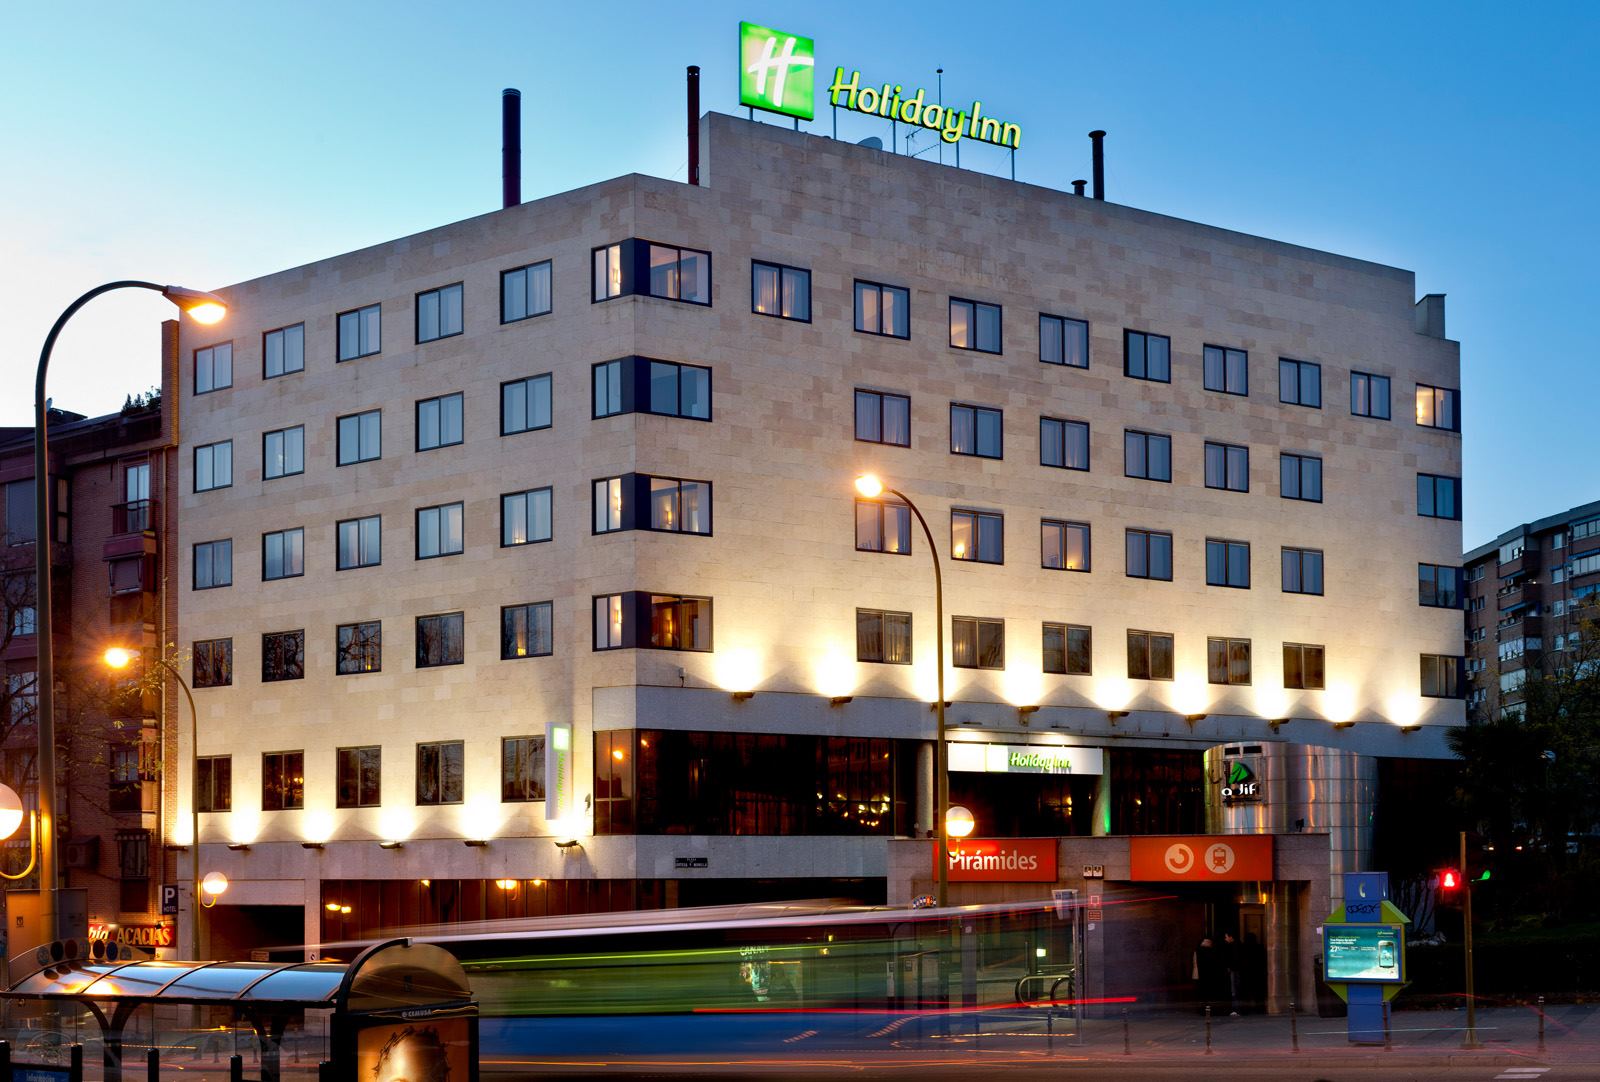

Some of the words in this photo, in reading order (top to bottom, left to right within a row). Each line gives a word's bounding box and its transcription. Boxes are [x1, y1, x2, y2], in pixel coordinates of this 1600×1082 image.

[827, 66, 966, 143] Holiday
[969, 100, 1022, 149] Inn
[1009, 751, 1052, 771] Holiday
[1052, 754, 1071, 769] Inn
[949, 849, 1038, 870] Pirámides
[164, 887, 176, 904] P
[163, 905, 177, 913] HOTEL
[117, 927, 171, 946] ACACIAS
